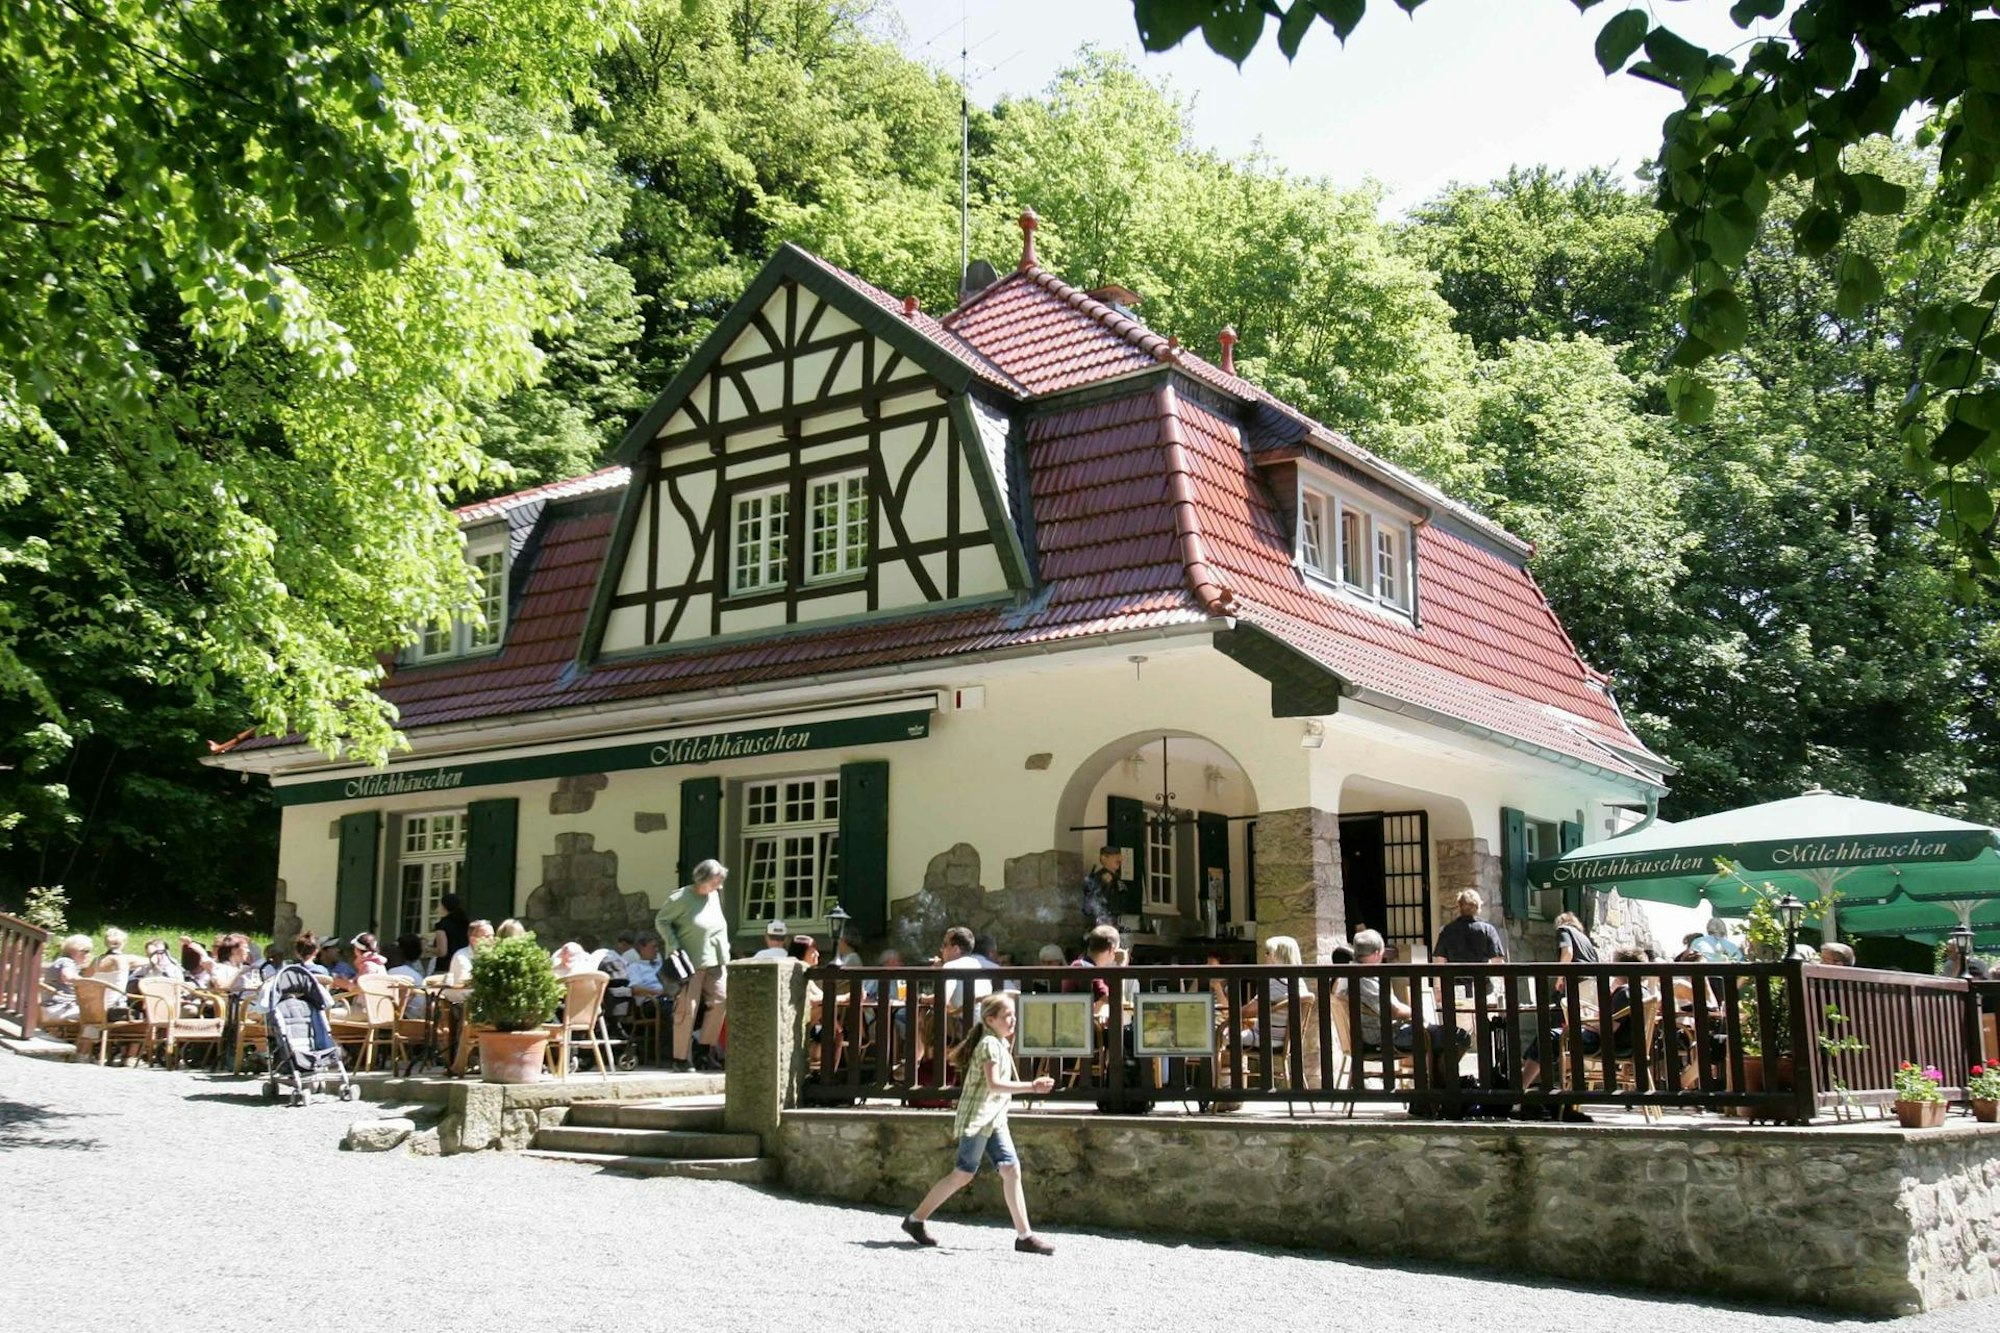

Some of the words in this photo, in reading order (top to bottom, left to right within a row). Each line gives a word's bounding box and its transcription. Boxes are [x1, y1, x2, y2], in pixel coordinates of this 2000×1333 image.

[650, 726, 811, 765] Milchhäuschen
[1771, 838, 1948, 864] Milchhäuschen
[1553, 853, 1704, 882] Milchhäuschen
